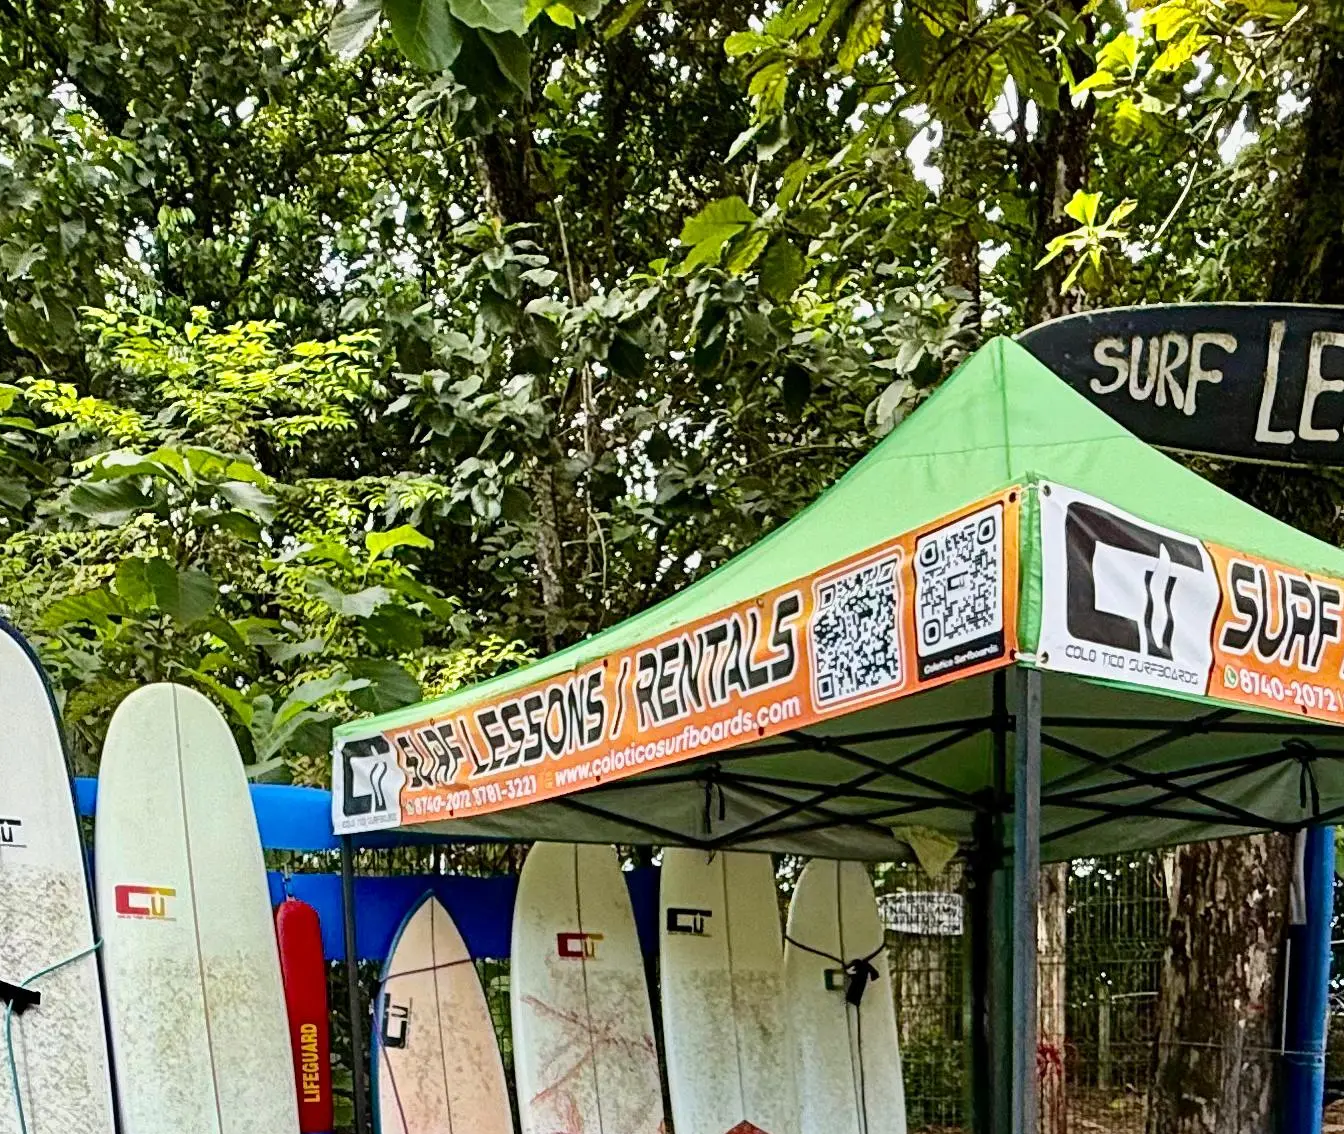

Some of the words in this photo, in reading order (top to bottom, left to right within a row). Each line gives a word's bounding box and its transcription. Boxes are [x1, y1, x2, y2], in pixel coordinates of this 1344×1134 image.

[1090, 331, 1237, 416] SURF
[1222, 562, 1342, 668] SURF
[396, 722, 463, 790] SURF
[460, 669, 605, 776] LESSONS
[612, 659, 629, 737] /
[634, 594, 800, 729] RENTALS
[1101, 652, 1125, 669] TICO
[1239, 669, 1338, 711] 8740-2072
[555, 695, 802, 788] www.coloticosurfboards.com
[300, 1022, 321, 1103] LIFEGUARD
